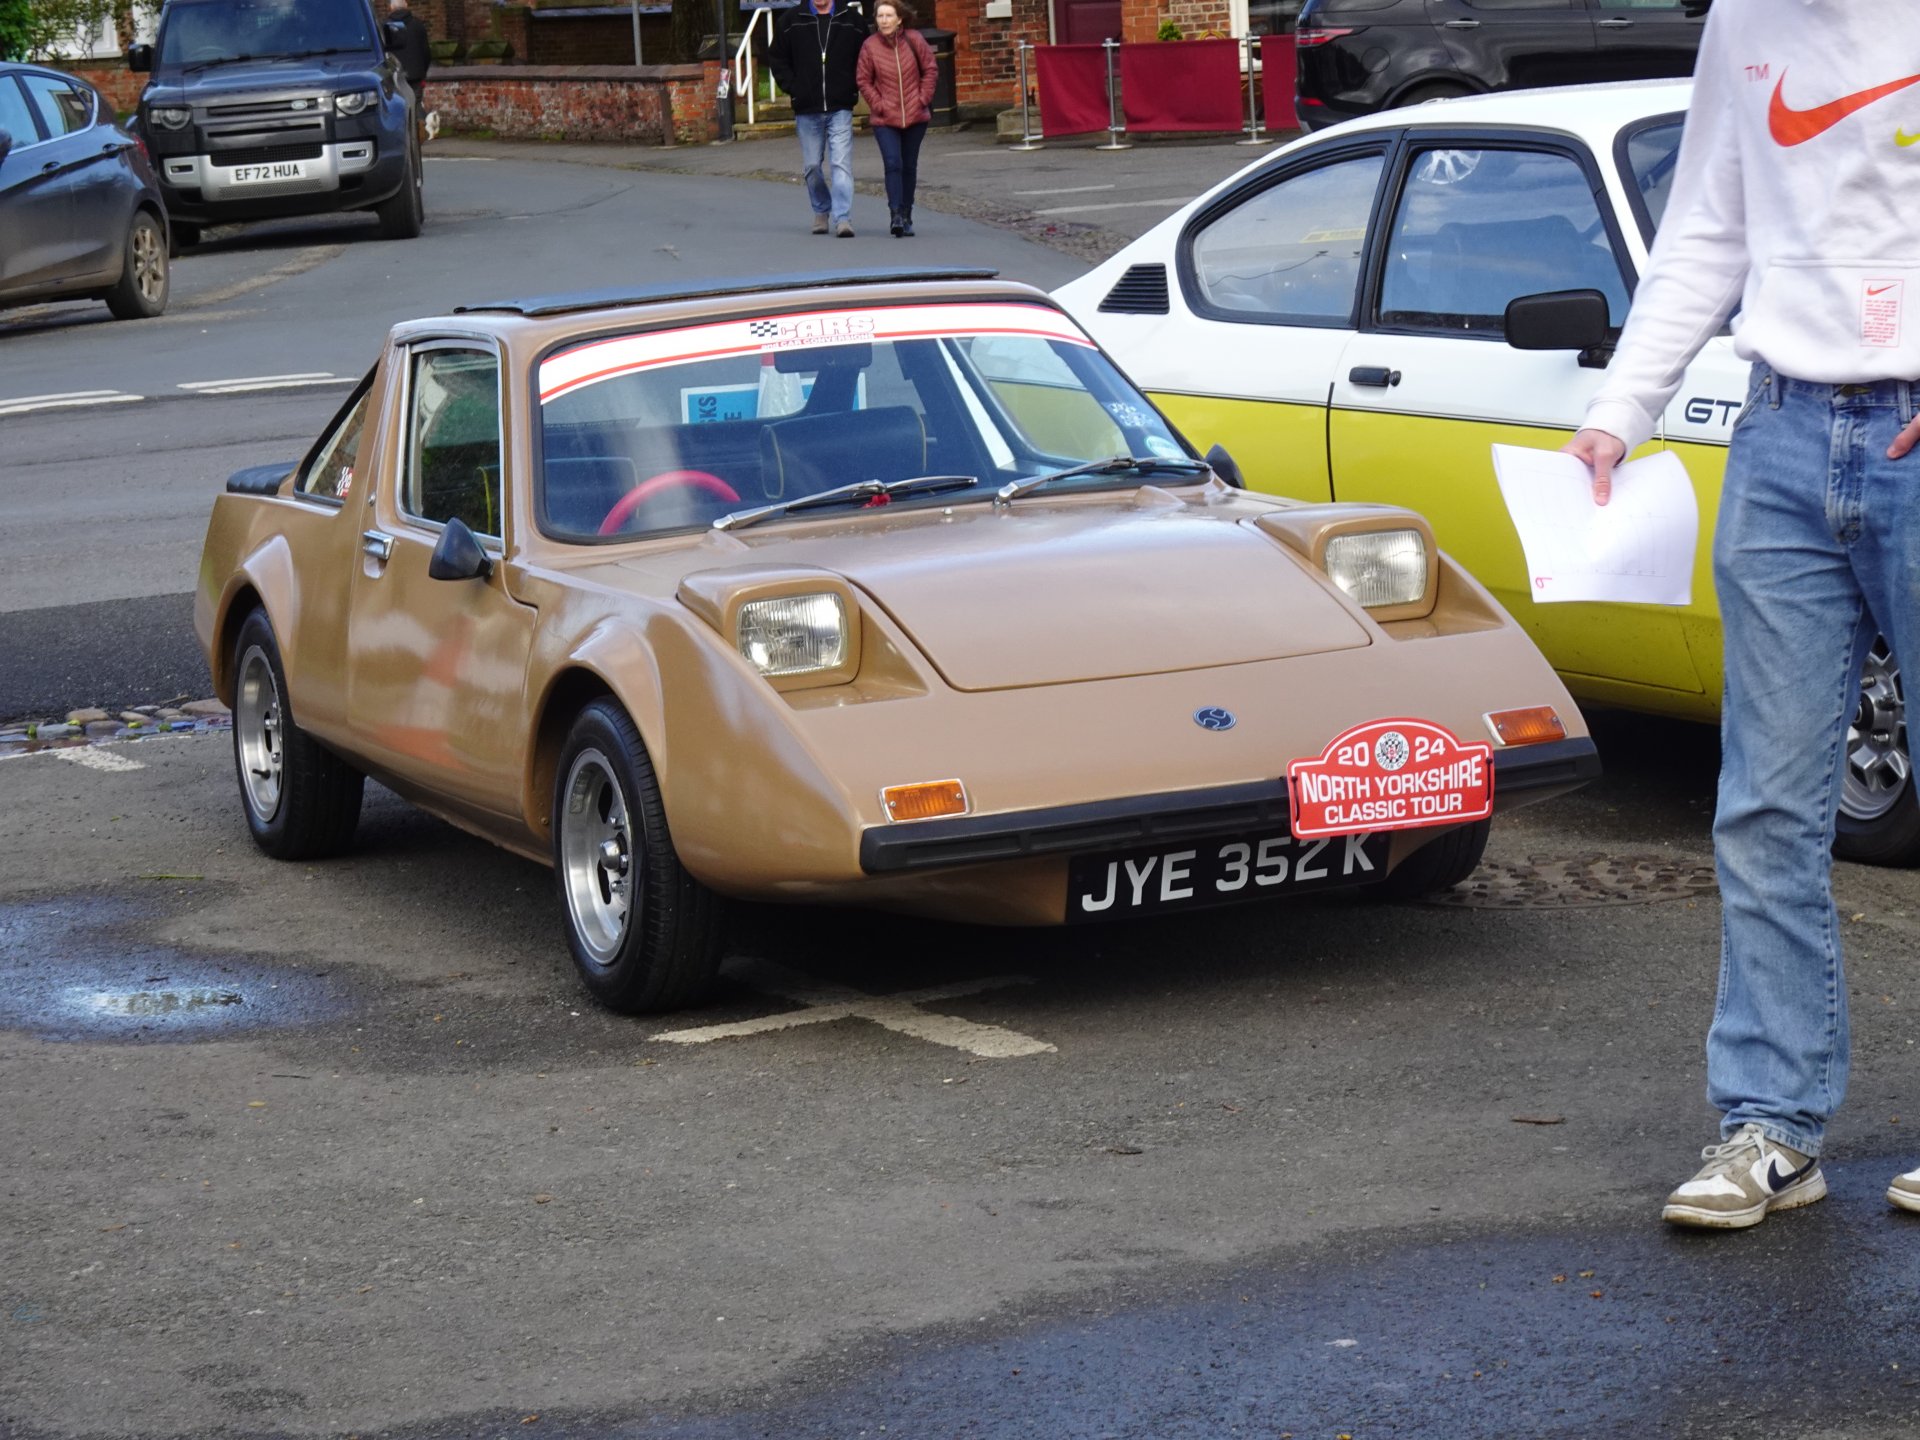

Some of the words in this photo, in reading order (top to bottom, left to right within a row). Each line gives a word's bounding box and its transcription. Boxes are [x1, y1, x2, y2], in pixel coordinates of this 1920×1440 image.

[1743, 63, 1769, 82] TM
[235, 166, 270, 181] EF72
[273, 163, 300, 178] HUA
[773, 315, 875, 339] CARS
[1685, 397, 1742, 426] GT
[1338, 741, 1370, 767] 20
[1414, 736, 1446, 762] 24
[1301, 771, 1370, 804] NORTH
[1374, 754, 1483, 797] YORKSHIRE
[1324, 799, 1406, 825] CLASSIC
[1410, 793, 1463, 815] TOUR
[1082, 850, 1197, 912] JYE
[1215, 836, 1331, 892] 352
[1343, 832, 1376, 875] K
